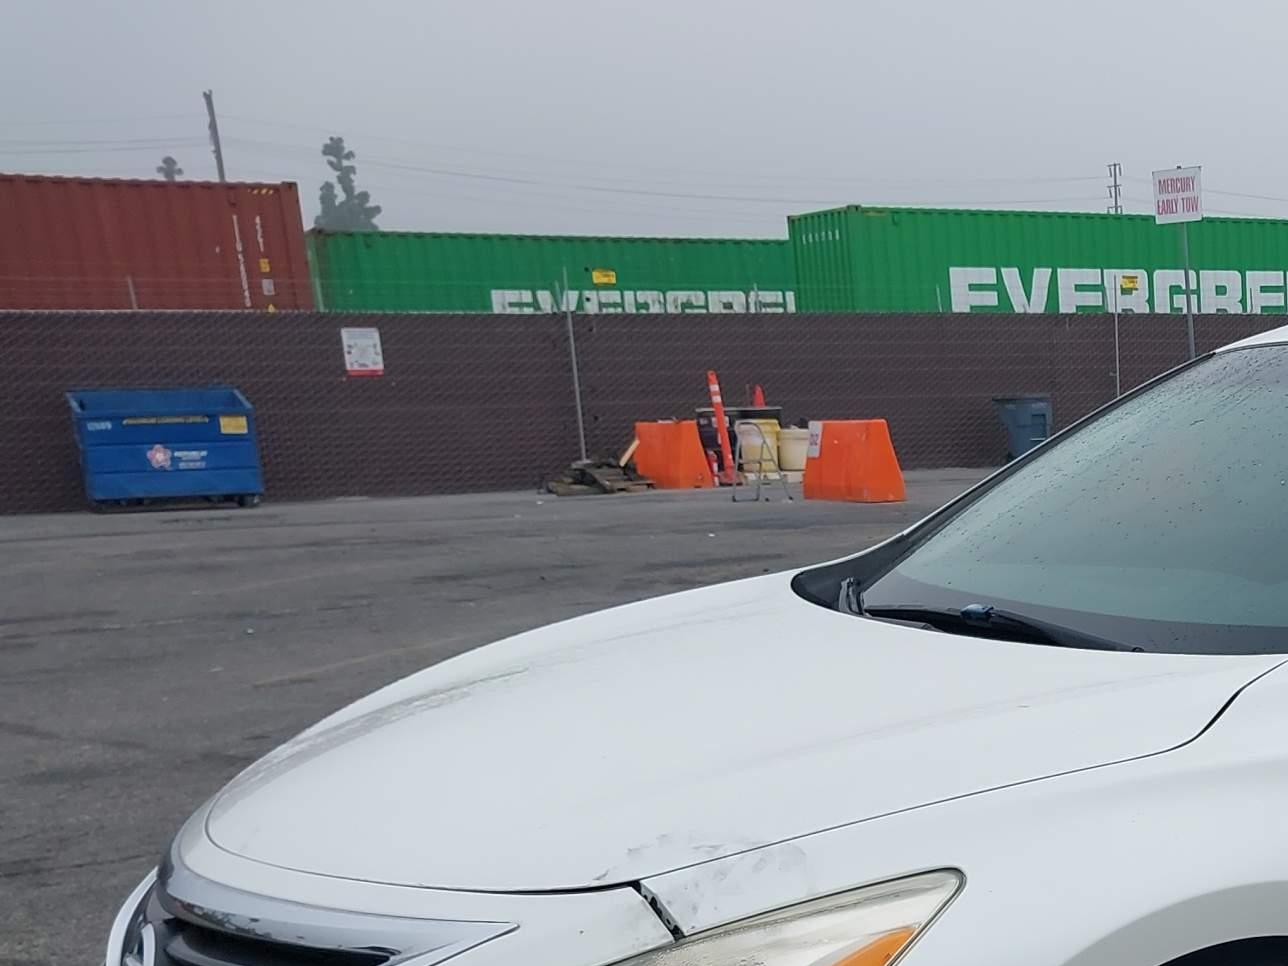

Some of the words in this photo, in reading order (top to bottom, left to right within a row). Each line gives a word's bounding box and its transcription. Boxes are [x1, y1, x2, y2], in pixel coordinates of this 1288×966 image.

[1158, 176, 1195, 194] MERCURY
[1157, 196, 1178, 215] EARLY
[1181, 196, 1198, 213] TOW
